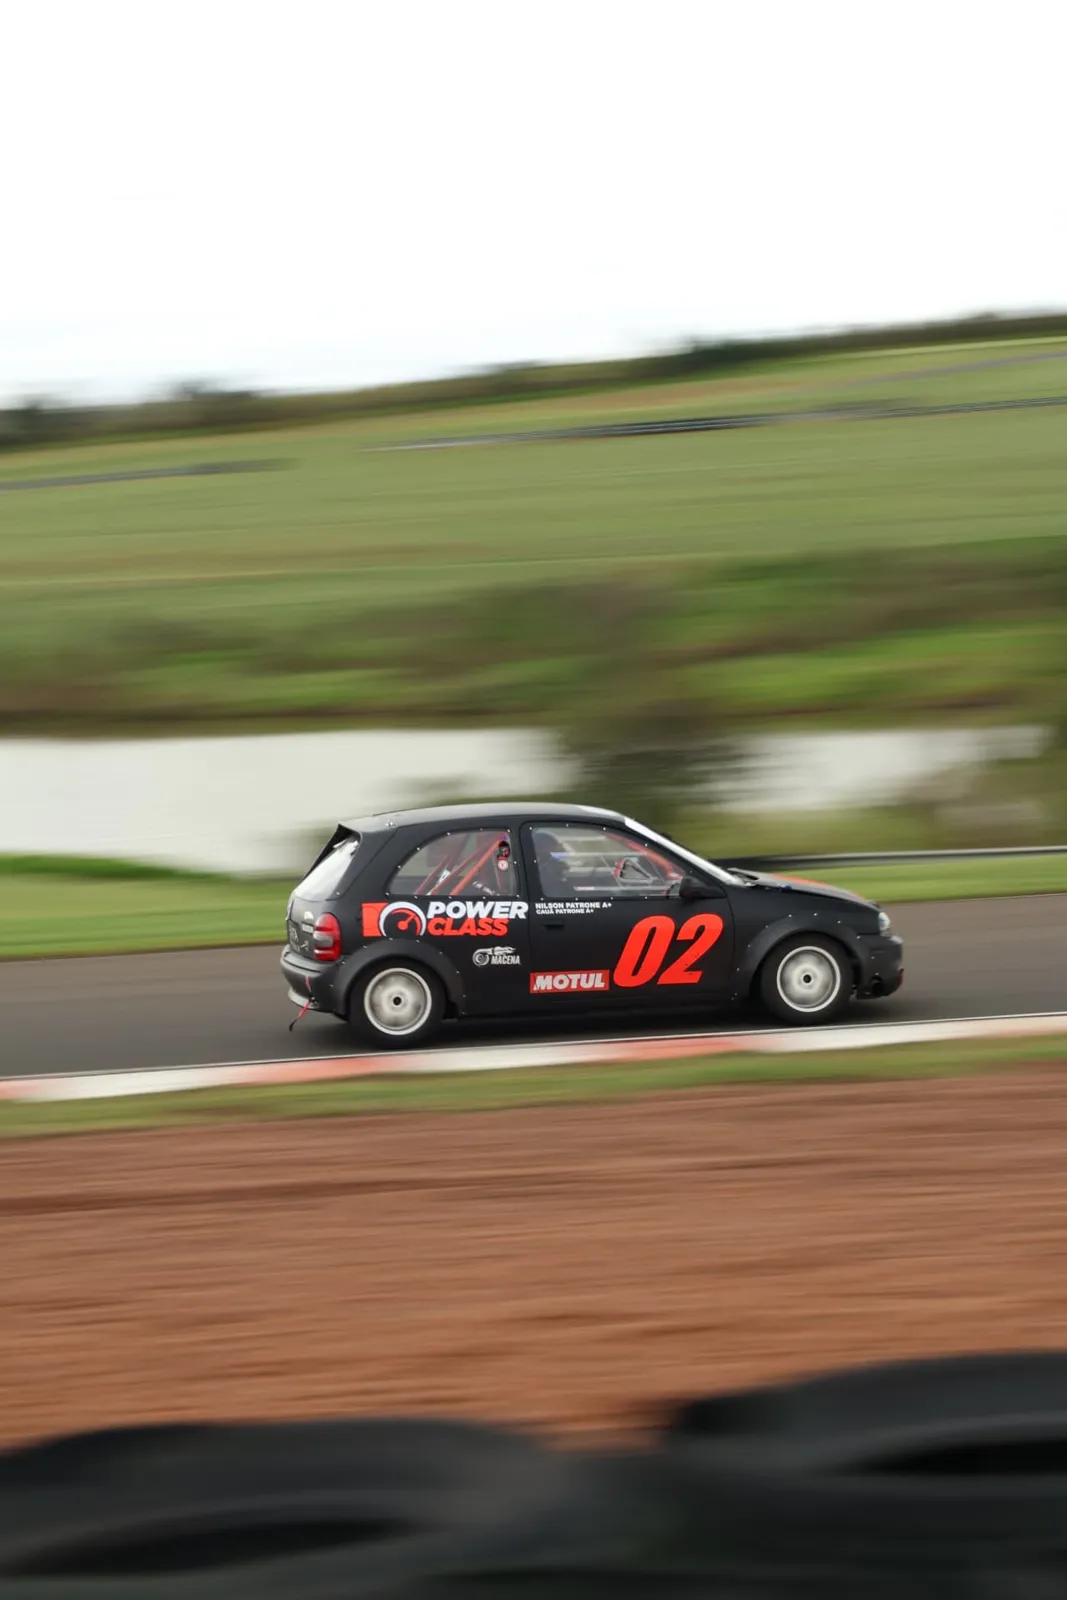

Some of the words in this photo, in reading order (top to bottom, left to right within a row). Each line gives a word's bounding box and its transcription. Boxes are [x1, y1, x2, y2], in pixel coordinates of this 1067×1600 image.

[427, 901, 529, 919] POWER
[427, 918, 510, 937] CLASS
[613, 913, 724, 988] 02
[533, 973, 605, 991] MOTUL
